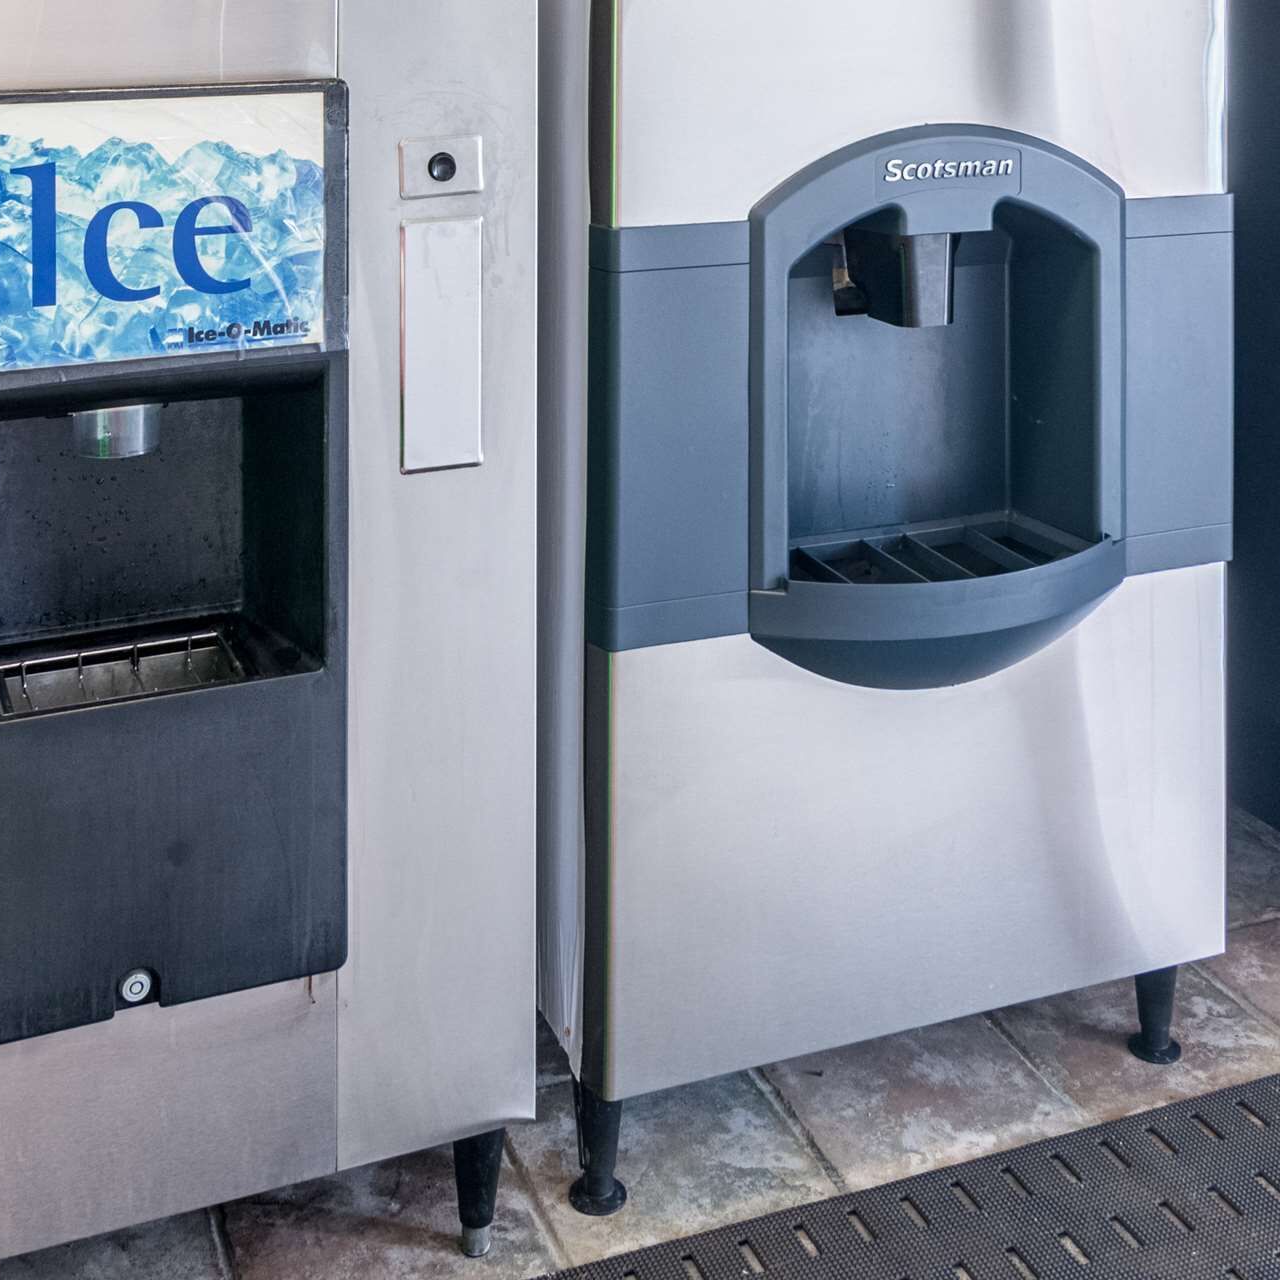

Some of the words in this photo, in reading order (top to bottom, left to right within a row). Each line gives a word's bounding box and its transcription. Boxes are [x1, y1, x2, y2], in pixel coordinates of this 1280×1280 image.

[884, 158, 1014, 183] Scotsman
[10, 161, 253, 308] Ice
[188, 317, 311, 344] Ice-O-Matic
